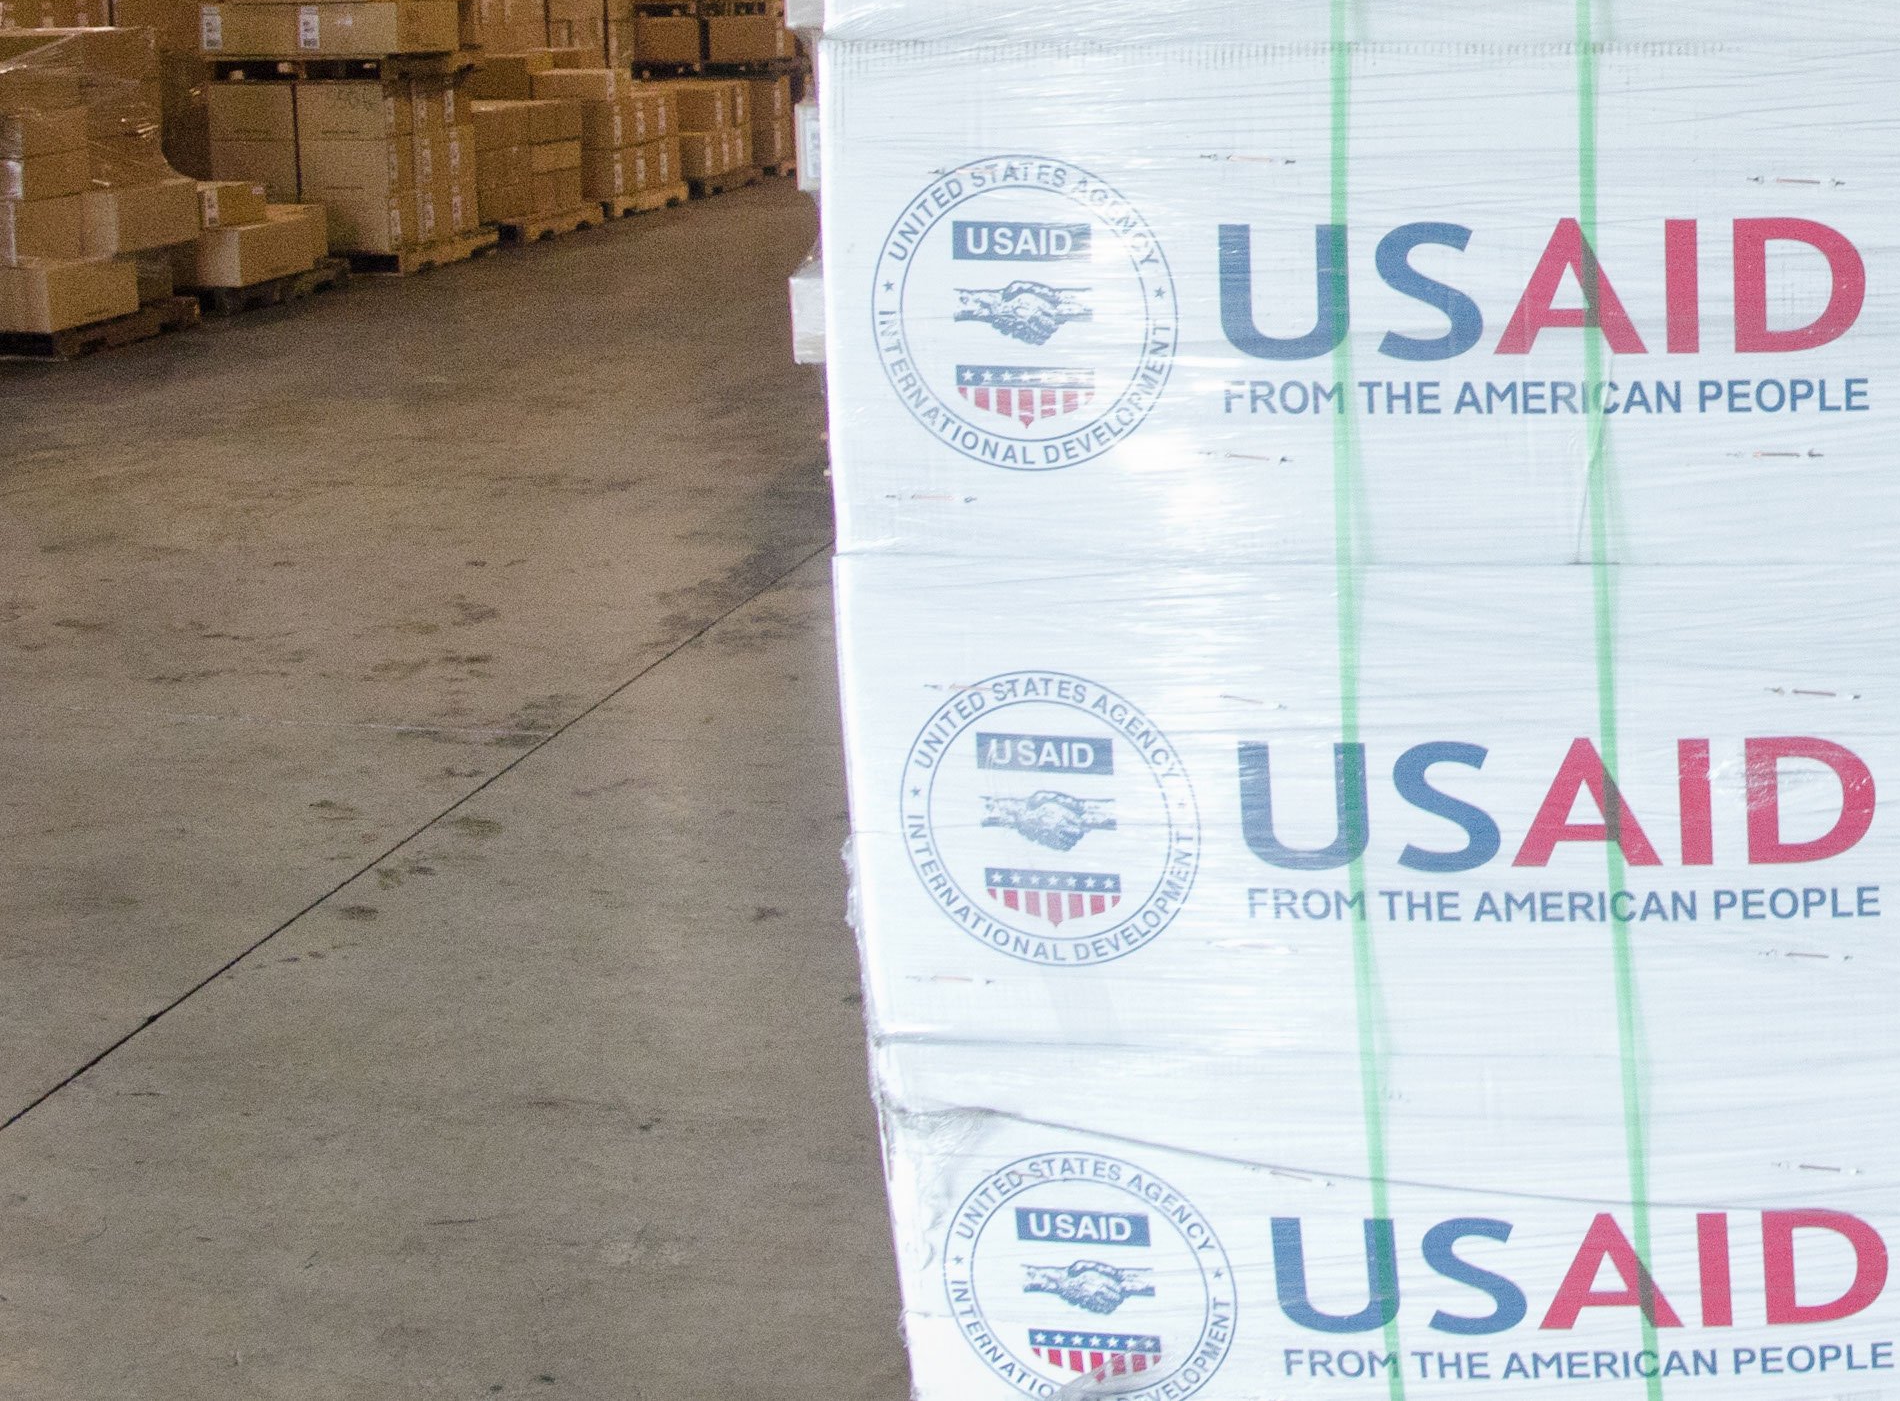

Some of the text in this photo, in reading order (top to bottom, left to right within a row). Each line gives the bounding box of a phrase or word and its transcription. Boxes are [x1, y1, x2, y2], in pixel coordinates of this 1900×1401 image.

[889, 176, 966, 264] UNITED
[970, 161, 1068, 189] STATES
[966, 228, 1073, 257] USAID
[1218, 217, 1866, 361] USAID
[878, 307, 1173, 467] INTERNATIONAL DEVELOPMENT
[1224, 378, 1870, 415] FROM THE AMERICAN PEOPLE
[914, 676, 1183, 781] UNITED STATES AGENCY
[989, 739, 1096, 769] USAID
[1238, 736, 1876, 872] USAID
[906, 811, 1195, 963] INTERNATIONAL DEVELOPMENT
[1248, 885, 1881, 923] FROM THE AMERICAN PEOPLE
[957, 1156, 1217, 1254] UNITED STATES AGENCY
[1027, 1213, 1132, 1242] USAID
[1271, 1207, 1889, 1336] USAID
[949, 1277, 1066, 1401] INTERNATIO
[1283, 1341, 1895, 1382] FROM THE AMERICAN PEOPLE
